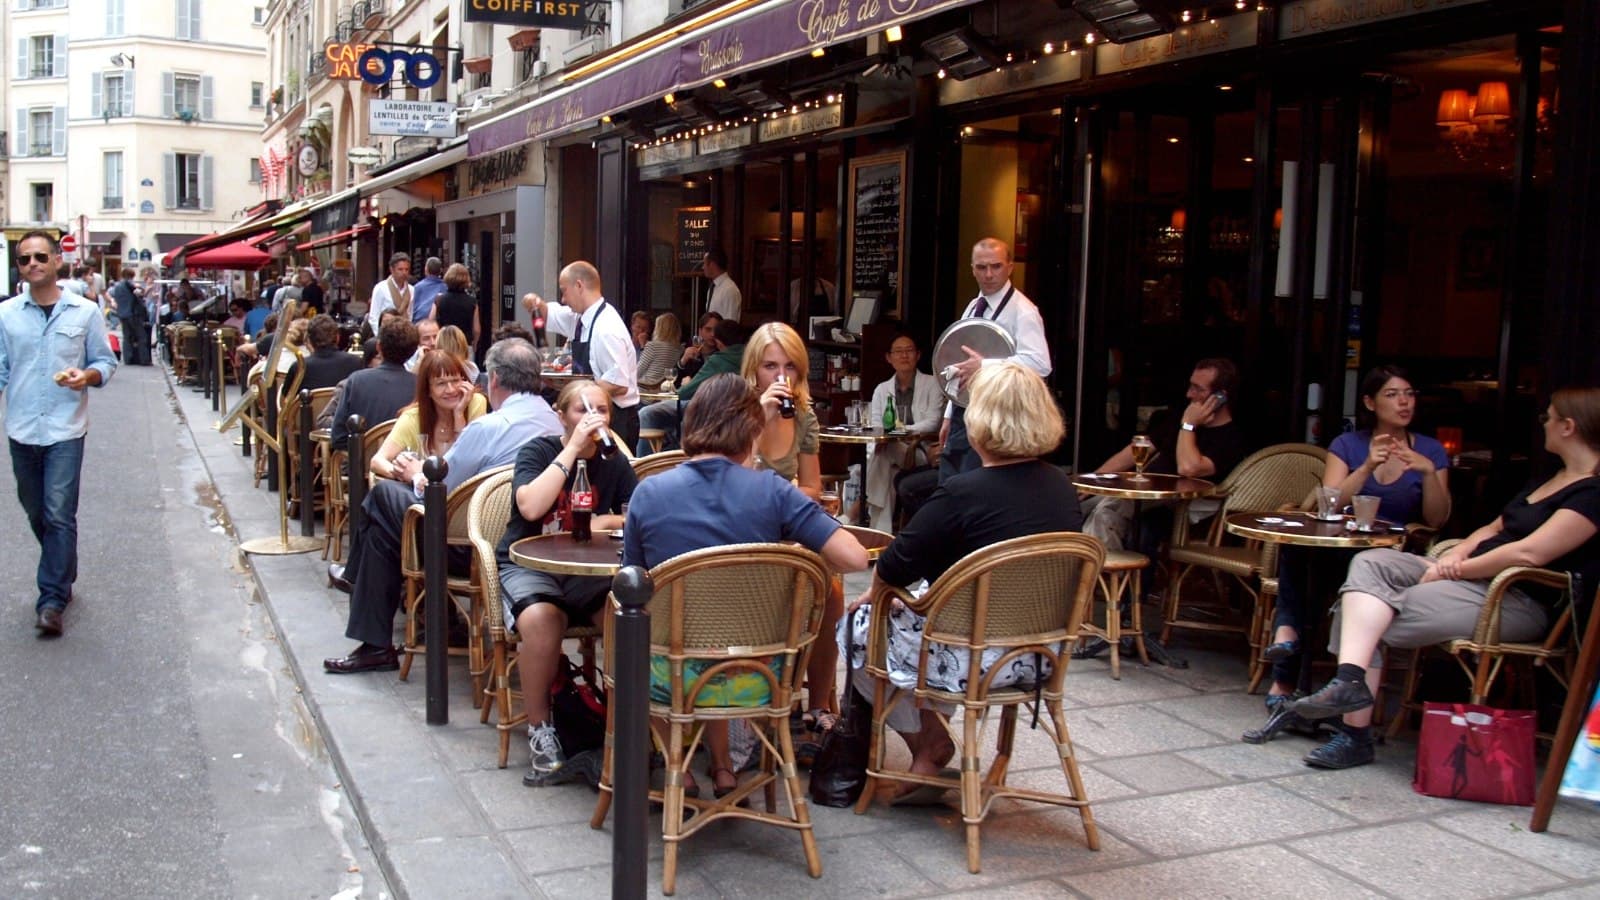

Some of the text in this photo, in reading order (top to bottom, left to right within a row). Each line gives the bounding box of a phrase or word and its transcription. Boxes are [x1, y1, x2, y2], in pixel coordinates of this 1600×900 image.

[472, 0, 580, 17] COIFFIRST
[798, 0, 850, 44] Café
[857, 0, 880, 22] de
[698, 38, 744, 75] Brasserie
[384, 103, 432, 112] LABORATOIRE
[373, 112, 409, 120] LENTILLES
[683, 219, 711, 229] SALLE
